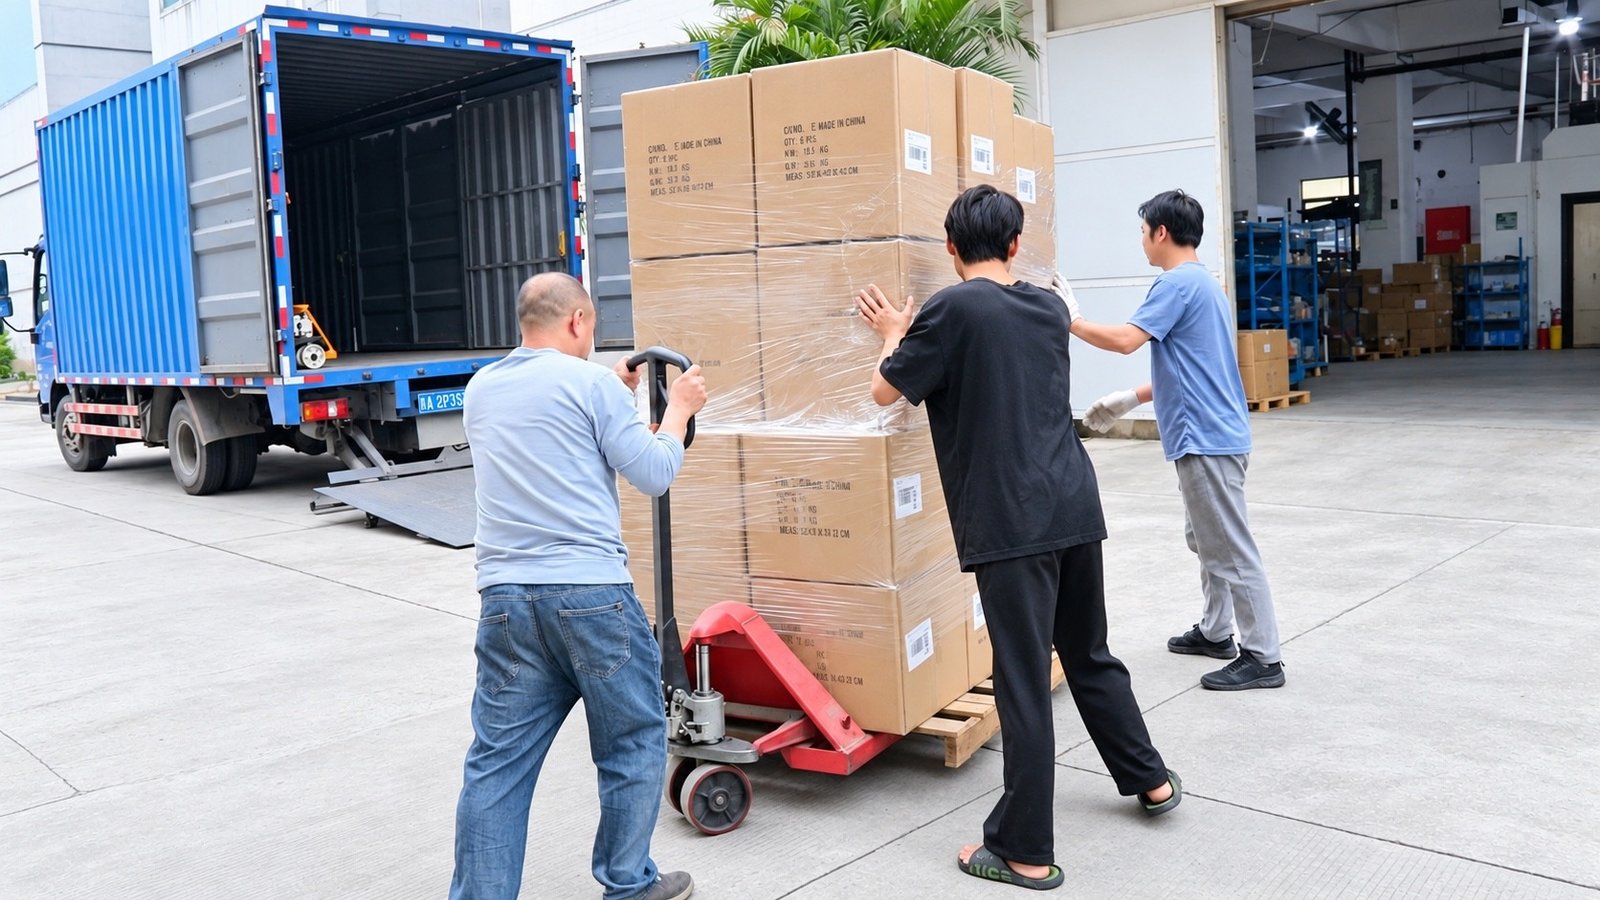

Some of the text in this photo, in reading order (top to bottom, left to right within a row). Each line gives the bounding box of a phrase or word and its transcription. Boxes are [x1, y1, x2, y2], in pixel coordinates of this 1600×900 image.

[819, 120, 836, 130] MADE
[837, 118, 845, 128] IN
[845, 115, 866, 127] CHINA
[703, 137, 722, 147] CHINA
[436, 392, 464, 408] 2P3S
